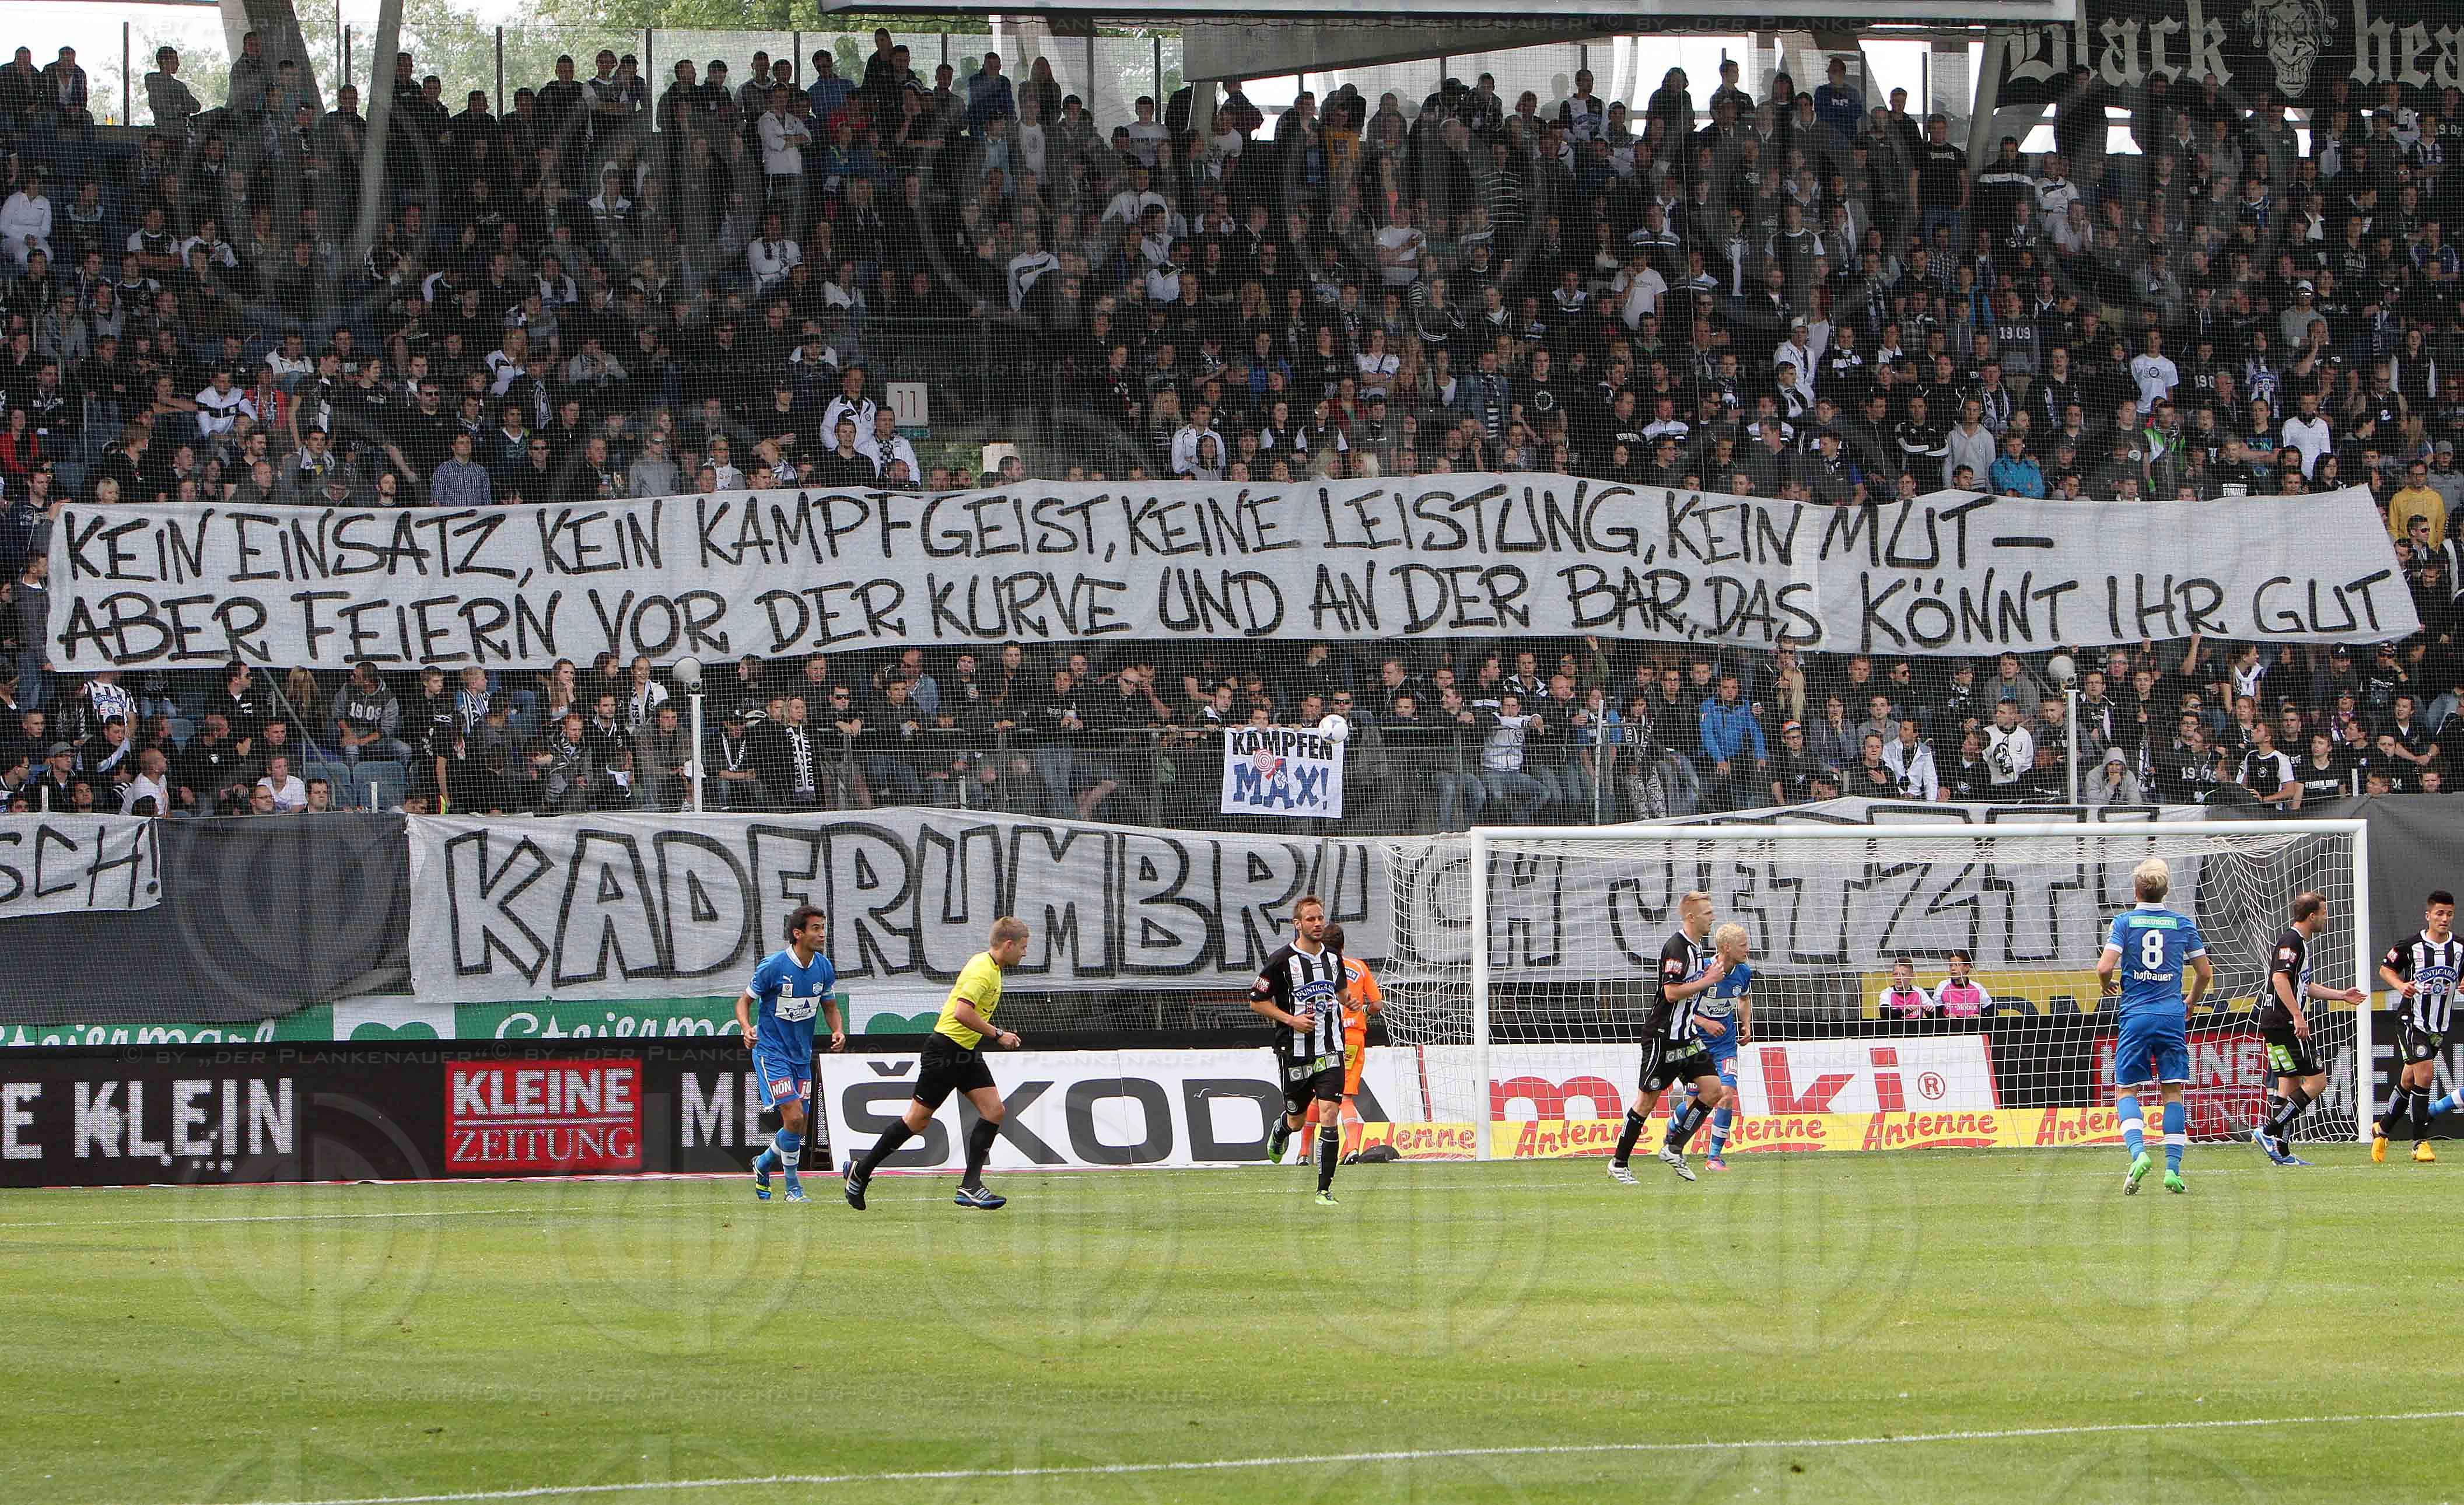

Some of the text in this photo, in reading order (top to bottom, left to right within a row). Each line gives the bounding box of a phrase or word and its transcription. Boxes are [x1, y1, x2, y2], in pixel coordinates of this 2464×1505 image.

[895, 389, 916, 418] 11
[65, 508, 214, 585] KEIN
[226, 508, 533, 588] EINSATZ,
[536, 499, 663, 575] KEIN
[698, 491, 1117, 568] KAMPFGEIST,
[1122, 489, 1300, 558] KEINE
[1318, 481, 1656, 564] LEISTUNG,
[1665, 490, 1804, 566] KEIN
[1819, 495, 1999, 569] MUT
[57, 559, 2392, 666] ABER FEIERN VOR DER KURVE UND AN DER BAR, DAS KÖNNT IHR GUT
[1233, 758, 1329, 811] MAX!
[2141, 929, 2163, 969] 8
[2133, 970, 2174, 981] hofbauer
[452, 1068, 634, 1116] KLEINE
[772, 1080, 792, 1097] NÖN
[74, 1077, 293, 1158] KLEIN
[1863, 1111, 1999, 1151] Antenne
[452, 1126, 635, 1162] ZEITUNG
